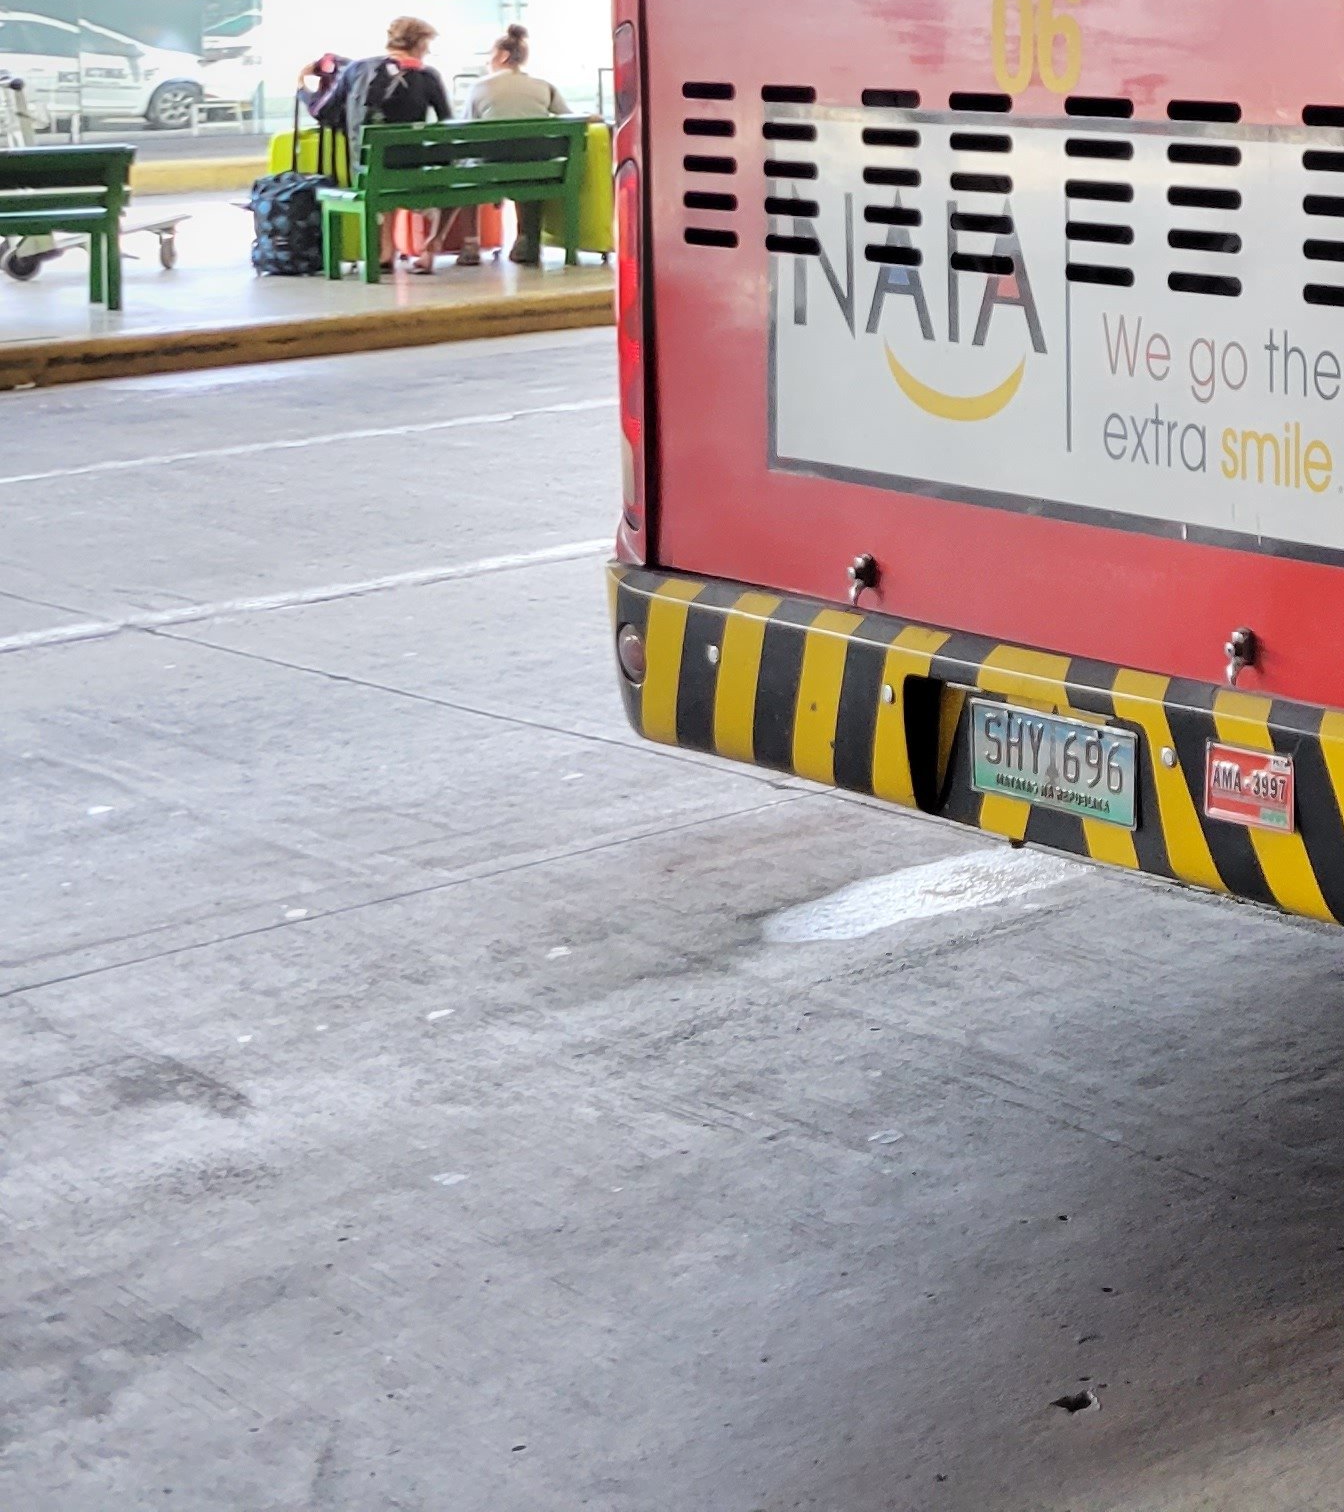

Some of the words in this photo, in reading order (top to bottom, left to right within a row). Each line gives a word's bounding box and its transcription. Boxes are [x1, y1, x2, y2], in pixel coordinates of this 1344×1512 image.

[792, 182, 1048, 355] NAIA
[1102, 311, 1171, 381] We
[1189, 337, 1248, 404] go
[1264, 328, 1342, 400] the
[1103, 403, 1207, 473] extra
[983, 711, 1045, 775] SHY
[1062, 729, 1124, 795] 696
